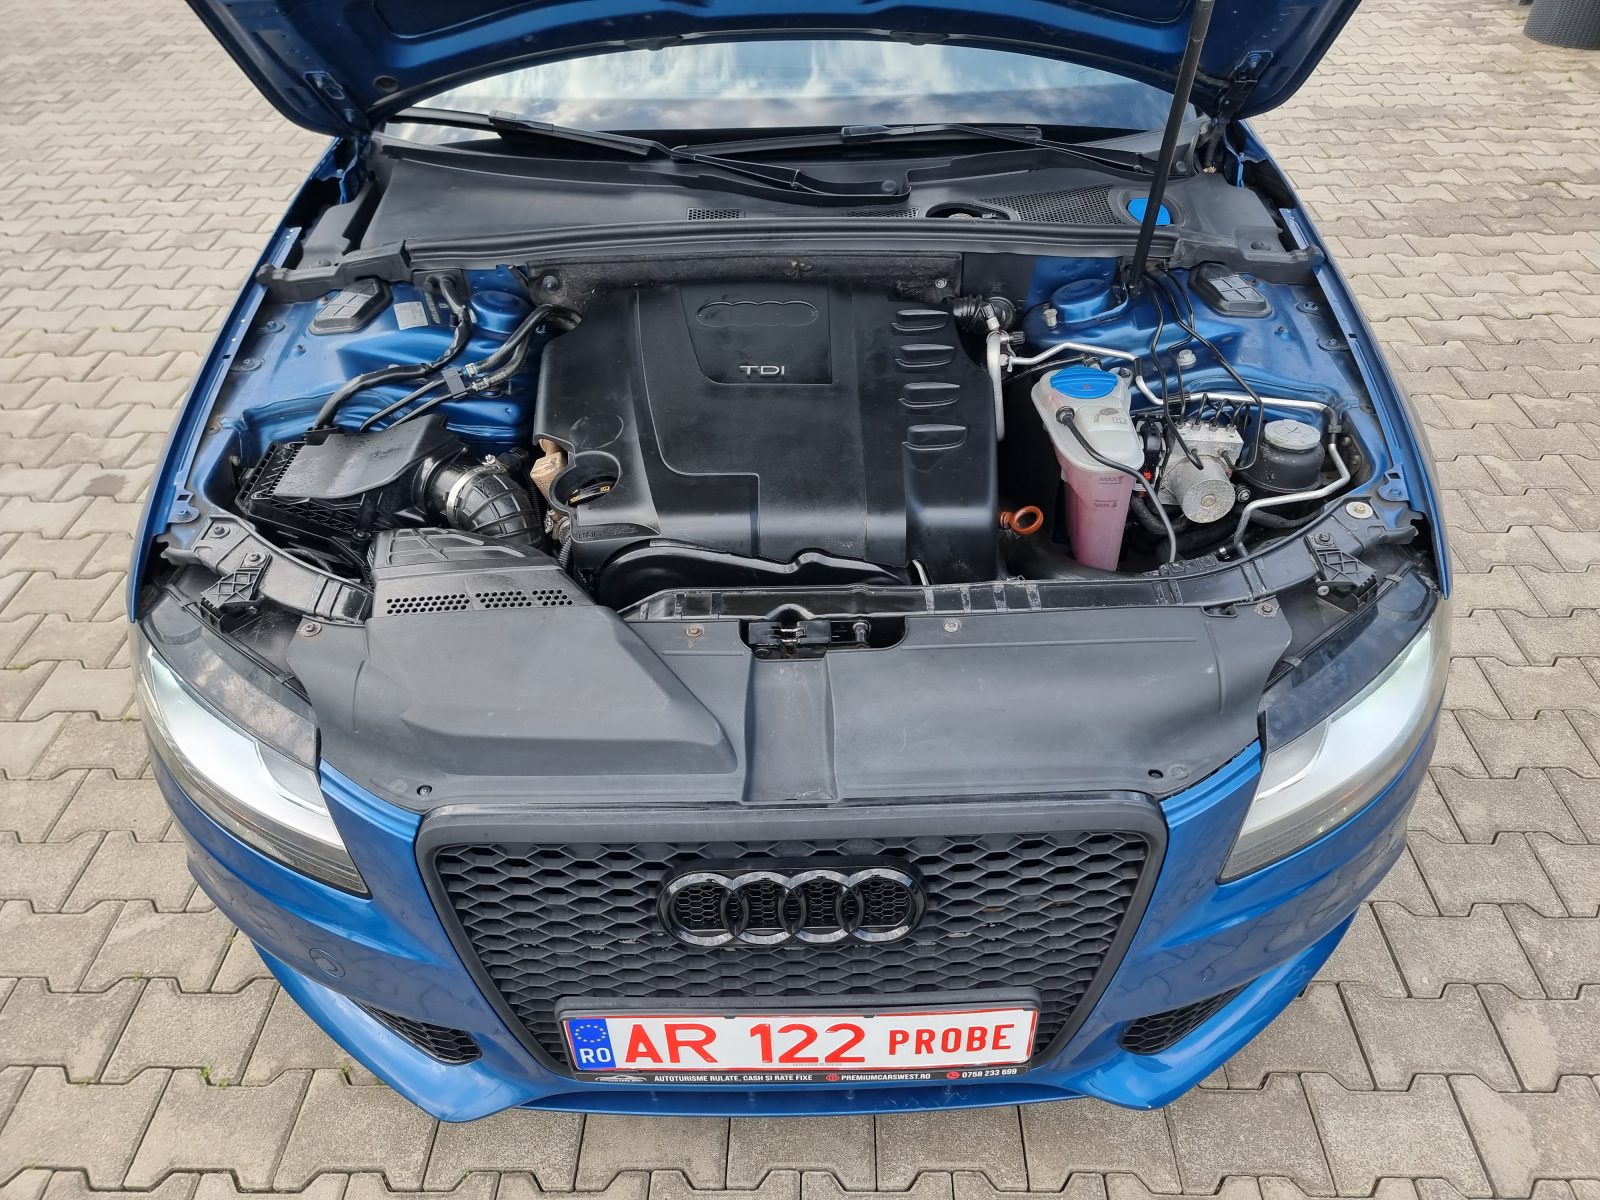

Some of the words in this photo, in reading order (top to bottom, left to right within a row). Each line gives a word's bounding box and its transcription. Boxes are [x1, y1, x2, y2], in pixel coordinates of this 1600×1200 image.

[739, 365, 785, 375] TDI
[625, 1023, 719, 1063] AR
[750, 1023, 865, 1063] 122
[888, 1023, 1015, 1056] PROBE
[579, 1048, 612, 1064] RO
[841, 1073, 931, 1081] PREMIUMCARSWEST.RO
[984, 1069, 1000, 1077] 233
[1001, 1068, 1018, 1076] 699
